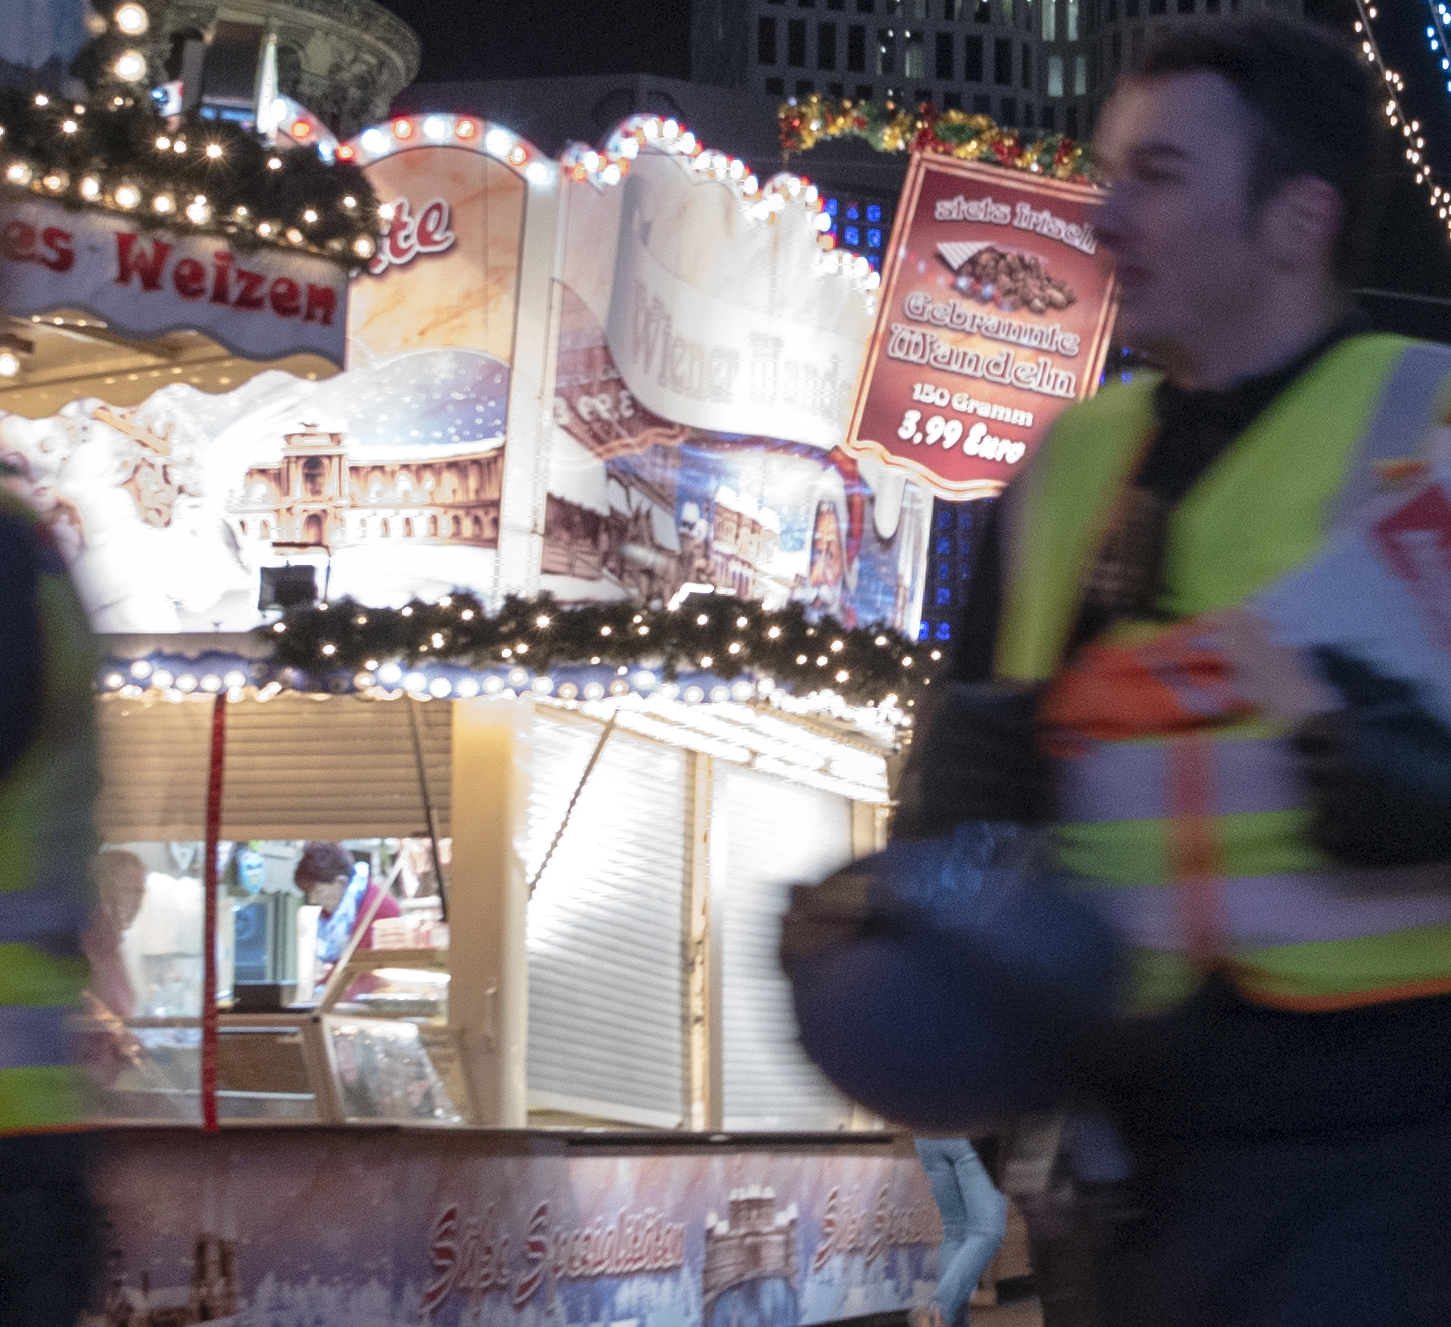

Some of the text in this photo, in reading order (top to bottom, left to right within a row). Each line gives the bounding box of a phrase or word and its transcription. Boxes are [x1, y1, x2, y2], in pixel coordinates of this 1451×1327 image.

[934, 195, 1097, 256] stets frisch
[113, 230, 338, 326] Weizen
[903, 290, 1081, 358] Gebrannte
[887, 321, 1078, 400] Mandeln
[897, 408, 1027, 465] 3,99 Euro
[912, 382, 1034, 428] 150 Gramm
